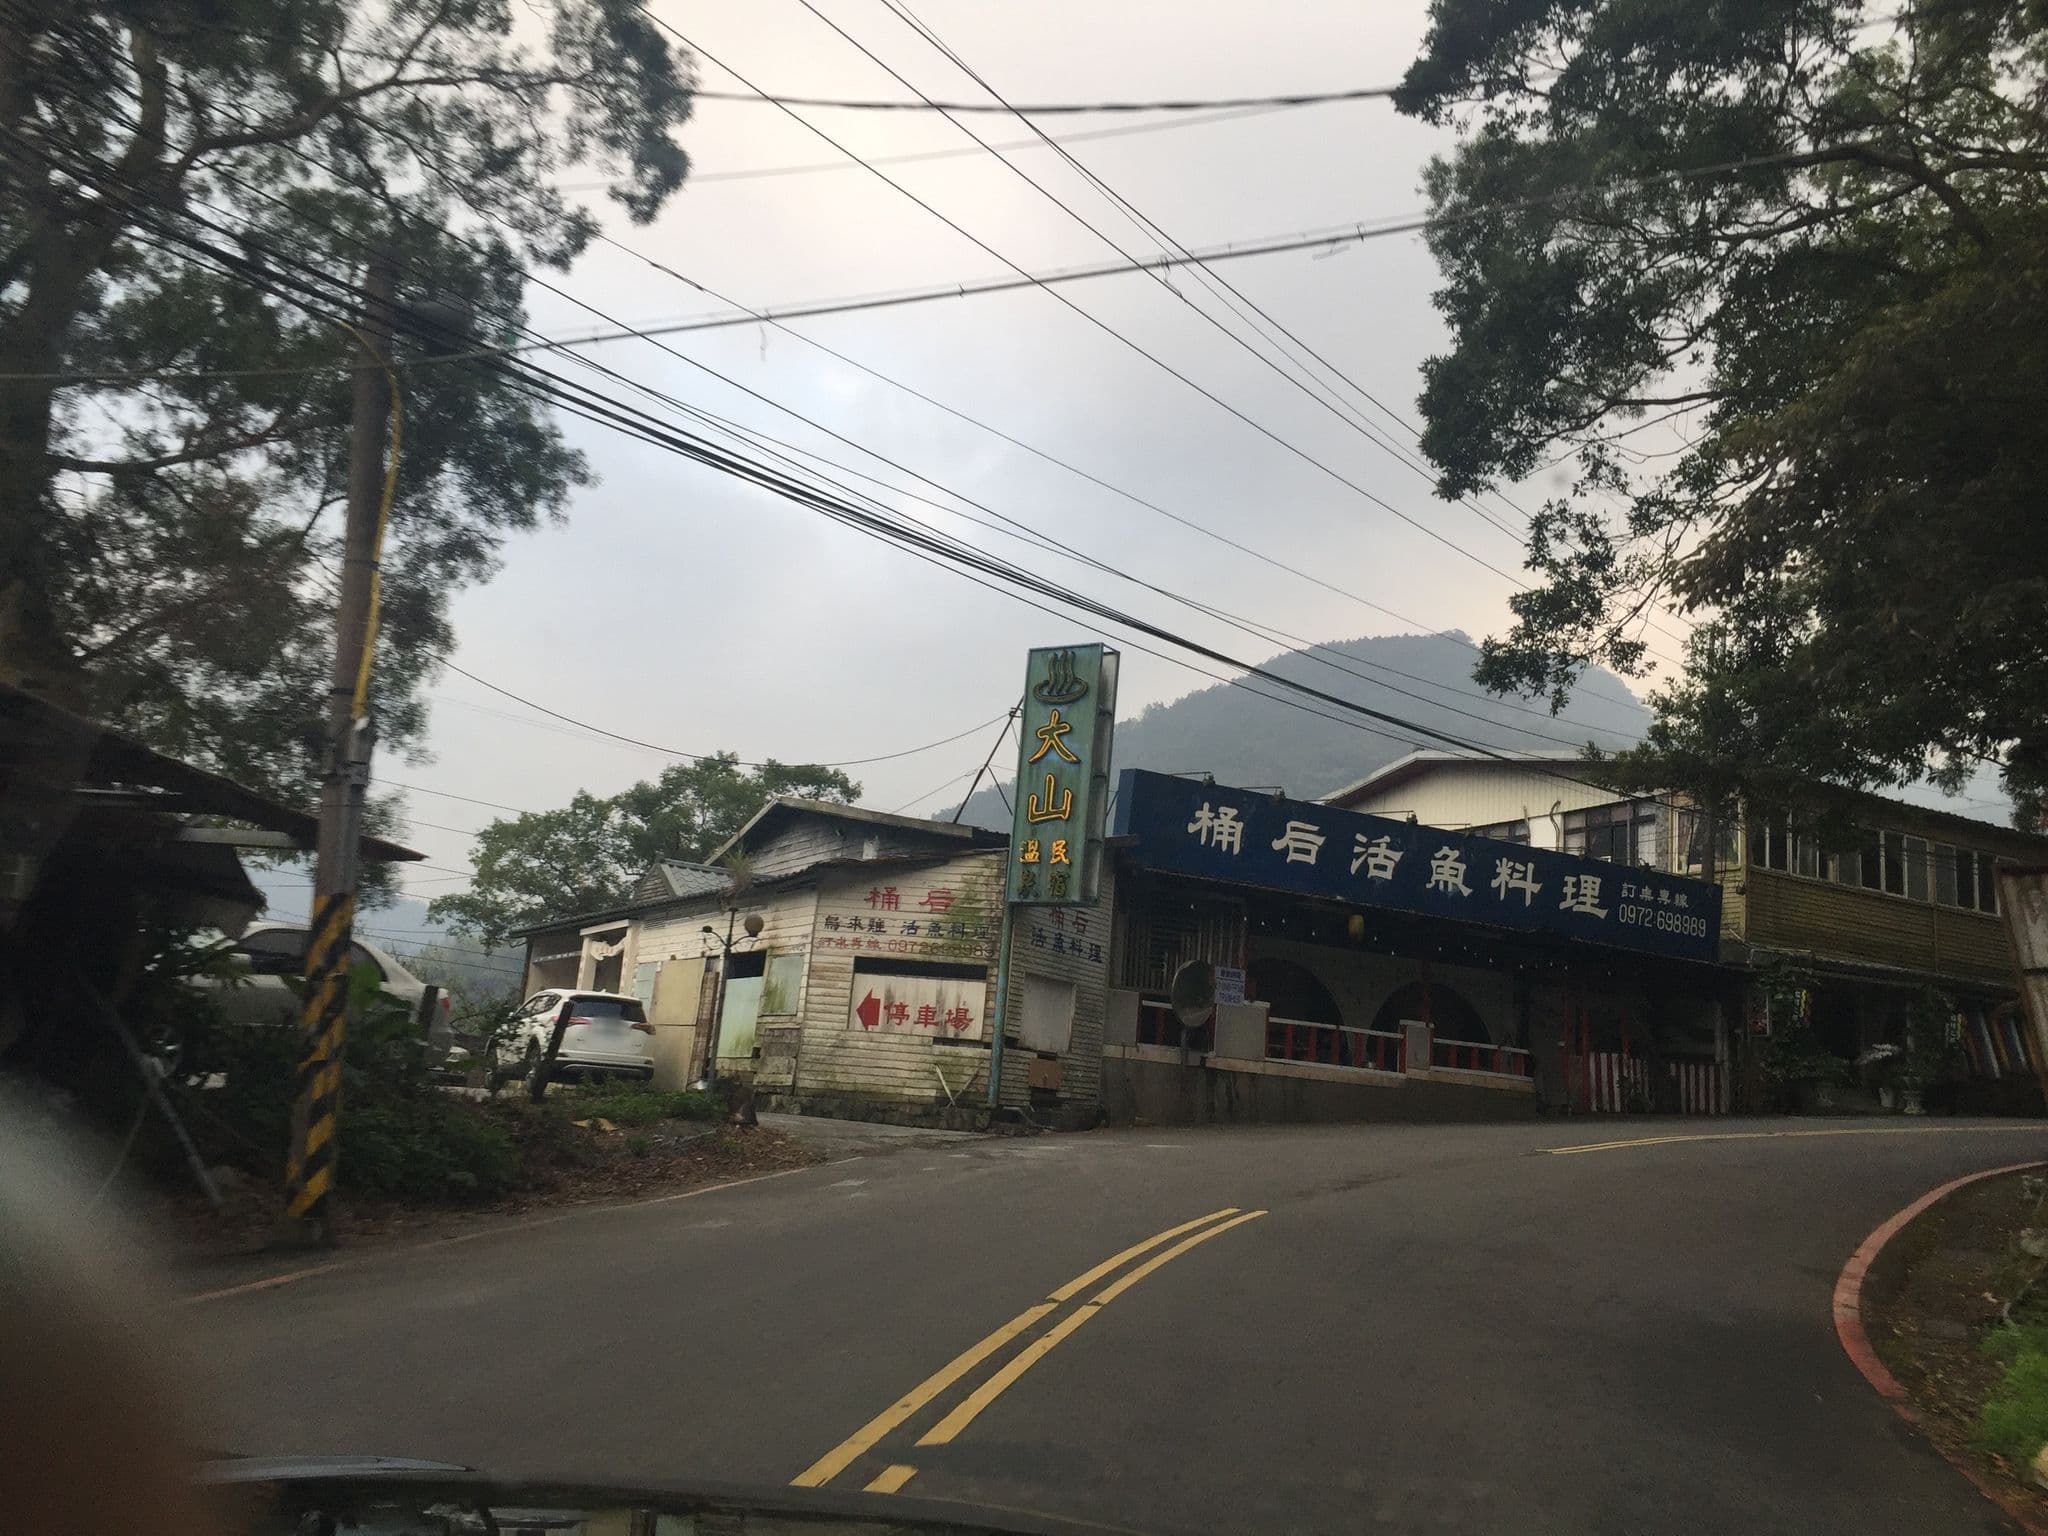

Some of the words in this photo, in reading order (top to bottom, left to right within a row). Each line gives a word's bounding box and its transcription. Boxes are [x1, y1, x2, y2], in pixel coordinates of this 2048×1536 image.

[1027, 708, 1081, 825] 大山
[1048, 839, 1072, 899] 民宿
[1187, 801, 1609, 920] 桶后活魚料理
[864, 886, 957, 913] 桶后
[1621, 882, 1689, 908] 訂桌專線
[900, 919, 991, 940] 活魚料理
[1031, 926, 1103, 963] 活魚料理
[883, 1000, 975, 1032] 停車場
